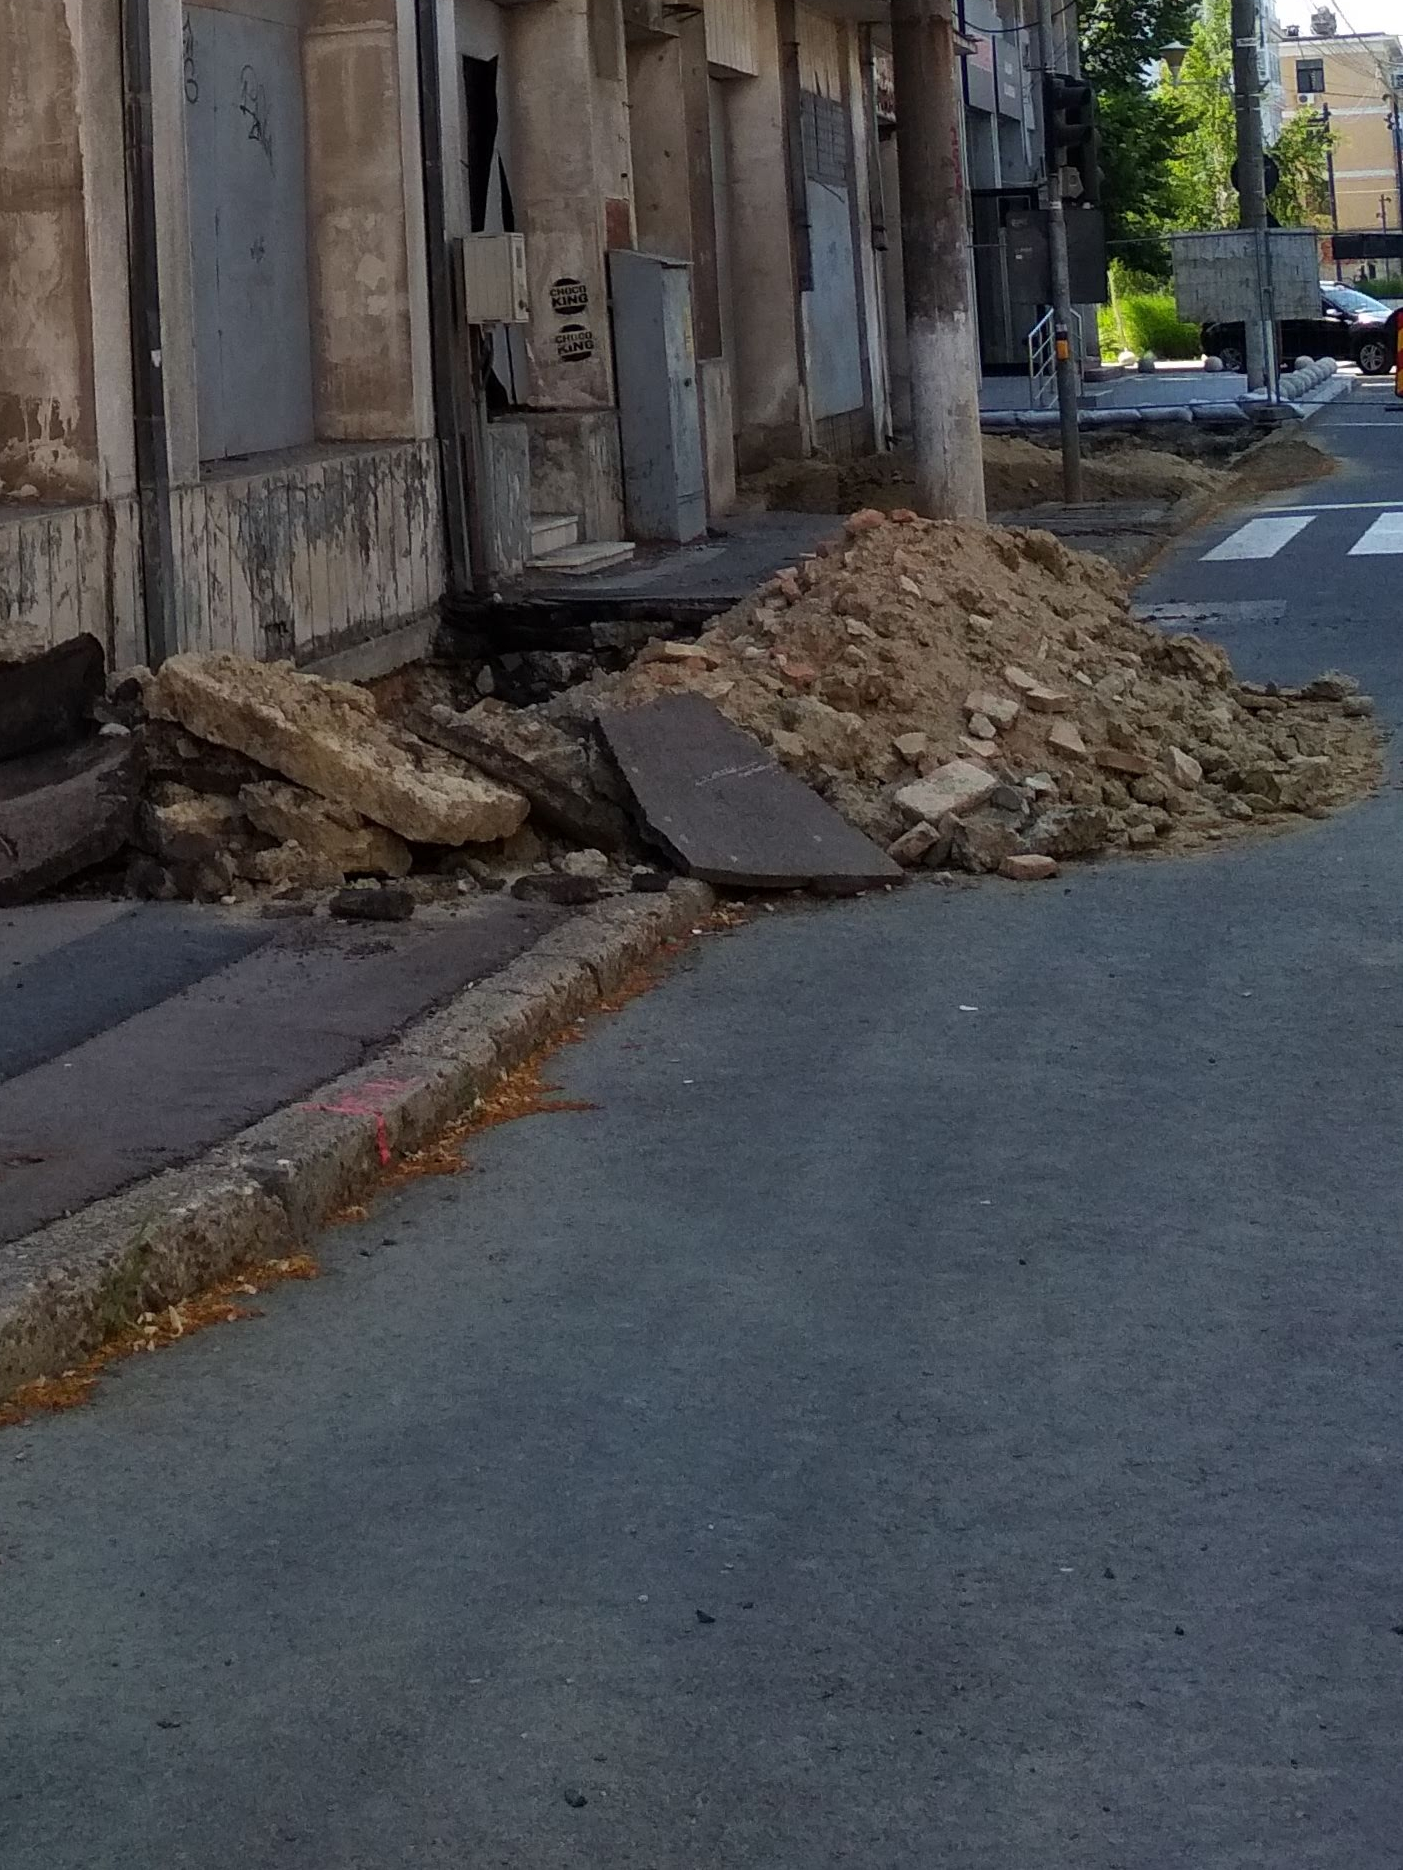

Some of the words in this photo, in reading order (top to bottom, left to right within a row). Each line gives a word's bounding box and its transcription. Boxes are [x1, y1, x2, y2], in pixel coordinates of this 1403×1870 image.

[549, 285, 587, 297] CHOCO
[551, 293, 589, 308] KING
[555, 331, 593, 344] CHOCO
[557, 339, 595, 355] KING
